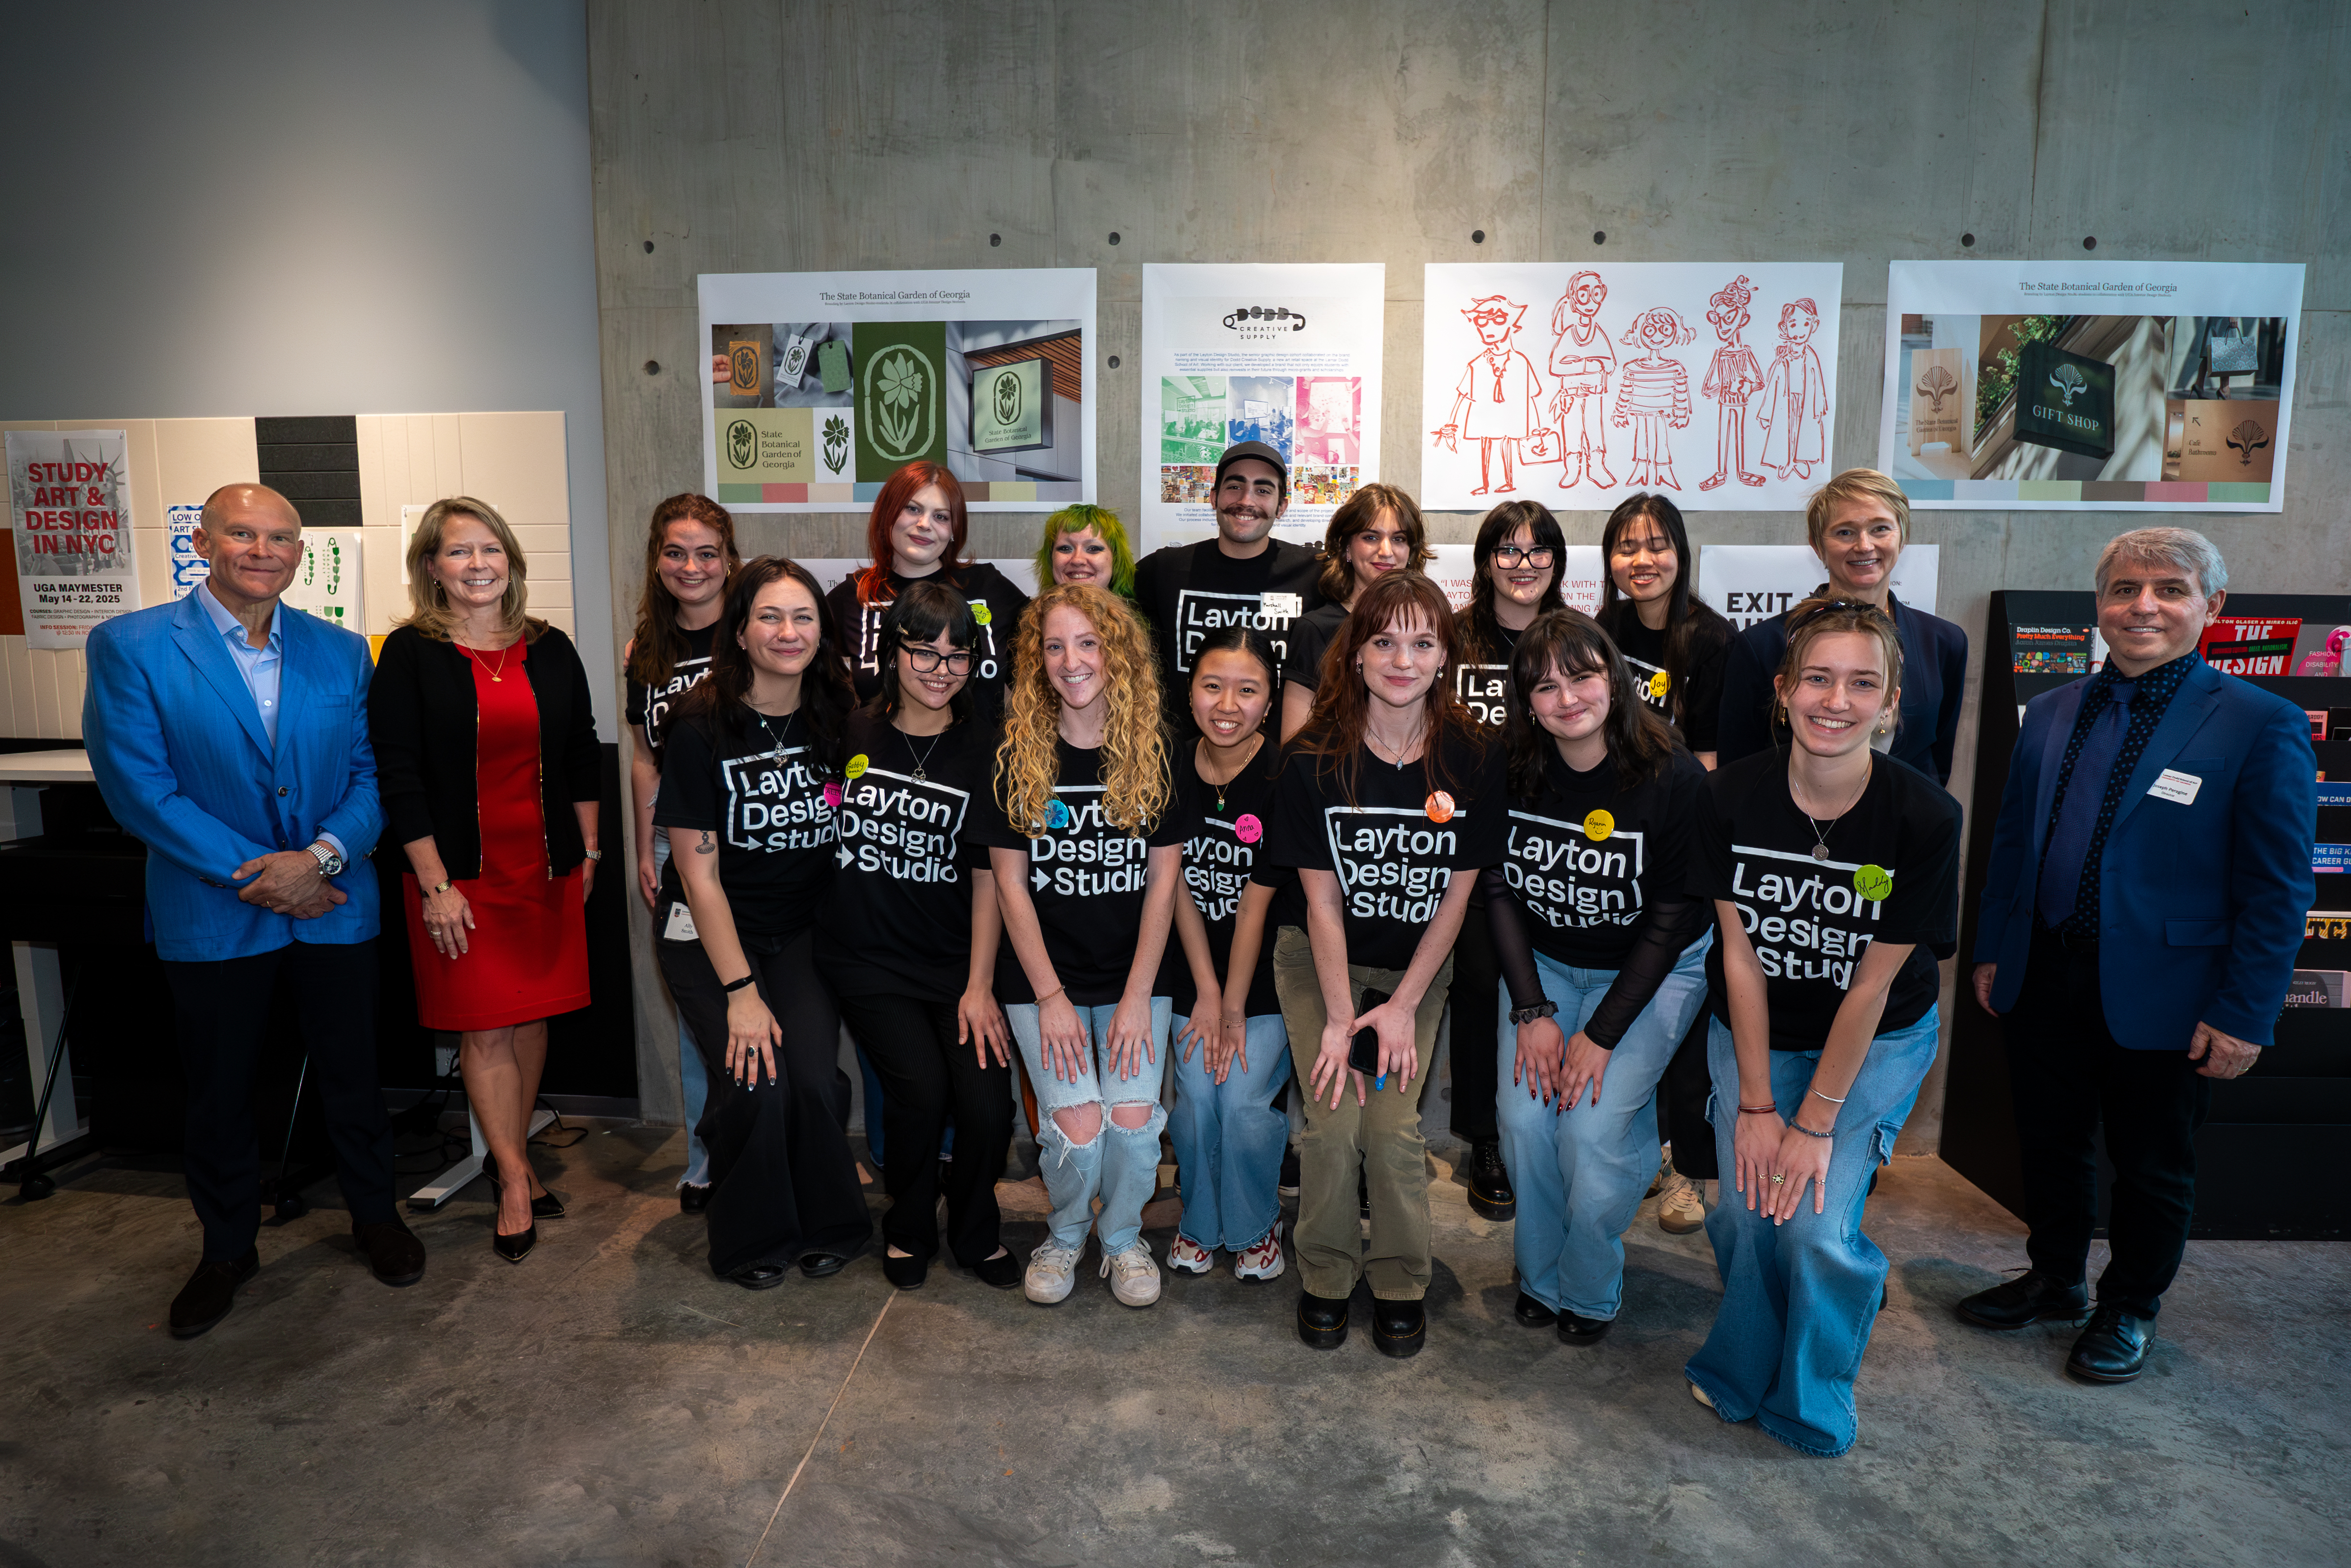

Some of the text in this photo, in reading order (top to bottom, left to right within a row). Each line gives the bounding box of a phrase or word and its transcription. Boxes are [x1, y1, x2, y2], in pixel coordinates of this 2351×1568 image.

[819, 292, 835, 300] The
[859, 291, 896, 300] Botanical
[929, 290, 938, 299] of
[939, 290, 970, 300] Georgia
[2019, 282, 2177, 293] The State Botanical Garden of Georgia
[1003, 426, 1028, 434] Botanical
[2033, 405, 2099, 431] GIFT SHOP
[28, 463, 108, 483] STUDY
[762, 461, 794, 470] Georgia
[34, 486, 106, 506] ART &
[26, 510, 118, 530] DESIGN
[33, 534, 115, 554] IN NYC
[33, 584, 123, 592] UGA MAYMESTER
[39, 594, 59, 605] May
[79, 595, 93, 604] 22,
[1727, 593, 1793, 613] EXIT
[2235, 625, 2273, 641] THE
[1651, 679, 1665, 692] Joy
[846, 761, 864, 772] Gabby
[740, 761, 831, 799] Layt
[2168, 787, 2188, 796] Peragine
[743, 792, 837, 830] Desig
[844, 778, 951, 828] Layton
[766, 816, 837, 853] Stud
[841, 810, 945, 857] Design
[1240, 824, 1255, 835] Anna
[1588, 817, 1606, 829] Ryann
[1031, 832, 1146, 866] Design
[1183, 836, 1253, 866] ayton
[1335, 821, 1456, 859] Layton
[1508, 826, 1626, 878] Layton
[858, 844, 957, 883] Studio
[1185, 864, 1251, 895] esign
[1342, 857, 1451, 897] Design
[1503, 861, 1625, 915] Design
[1856, 875, 1889, 900] Maddy
[1733, 862, 1881, 920] Layton
[1351, 891, 1441, 923] Studi
[1527, 900, 1642, 928] Studio
[1756, 946, 1853, 990] Stud
